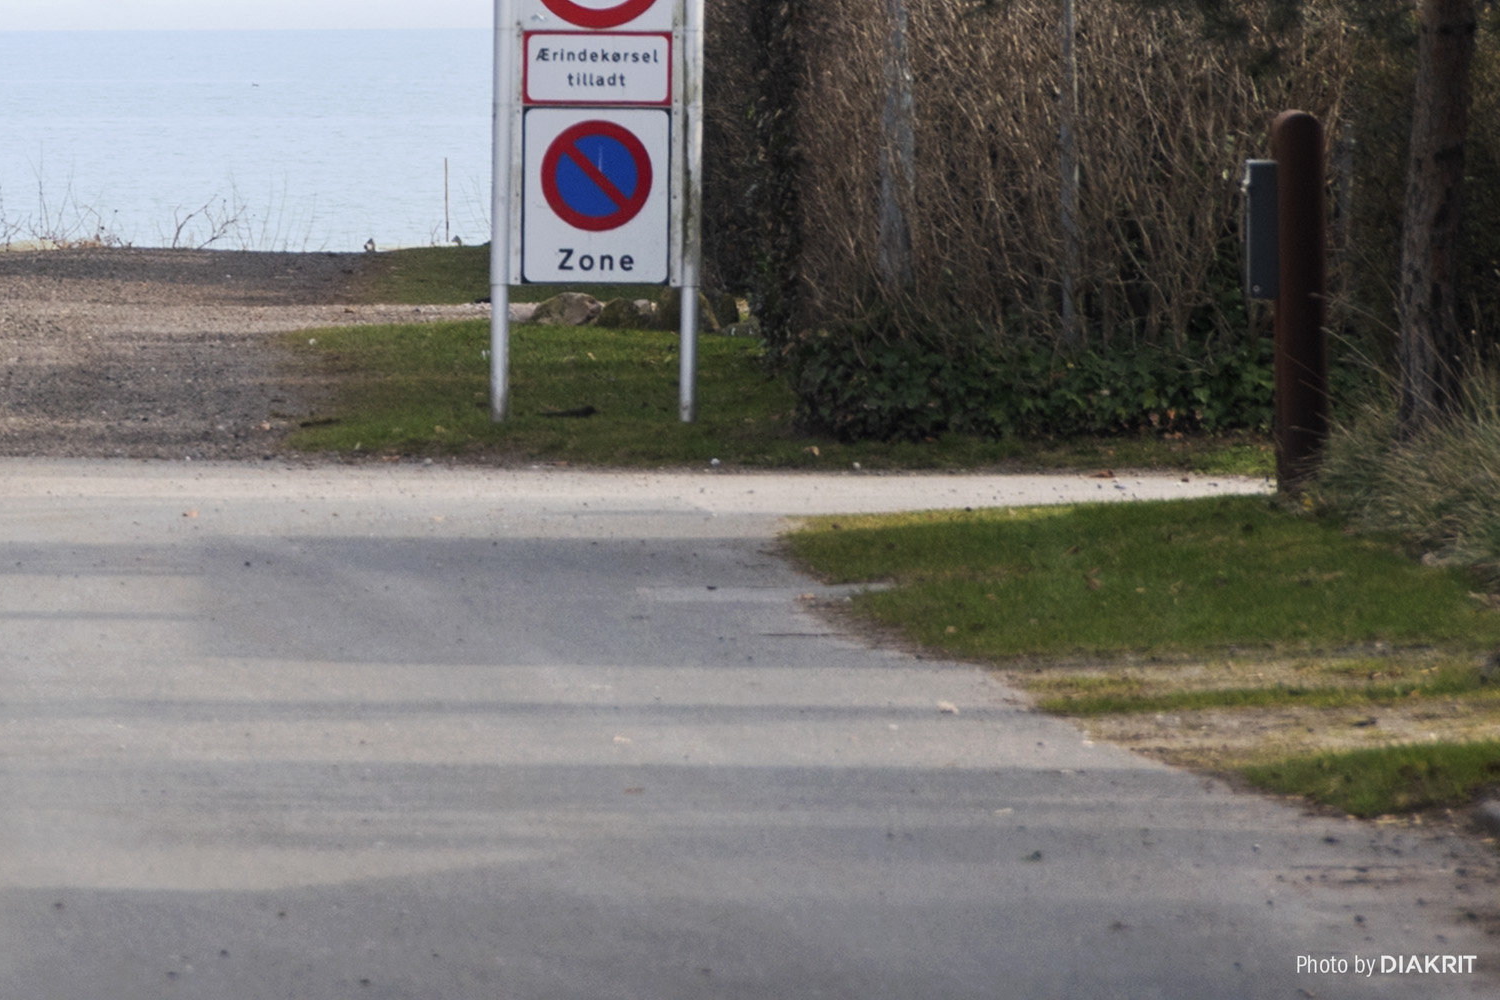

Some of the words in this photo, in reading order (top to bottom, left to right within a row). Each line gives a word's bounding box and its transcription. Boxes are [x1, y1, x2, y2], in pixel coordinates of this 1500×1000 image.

[536, 48, 658, 63] Ærindekørsel
[567, 73, 626, 87] tilladt
[558, 248, 634, 271] Zone
